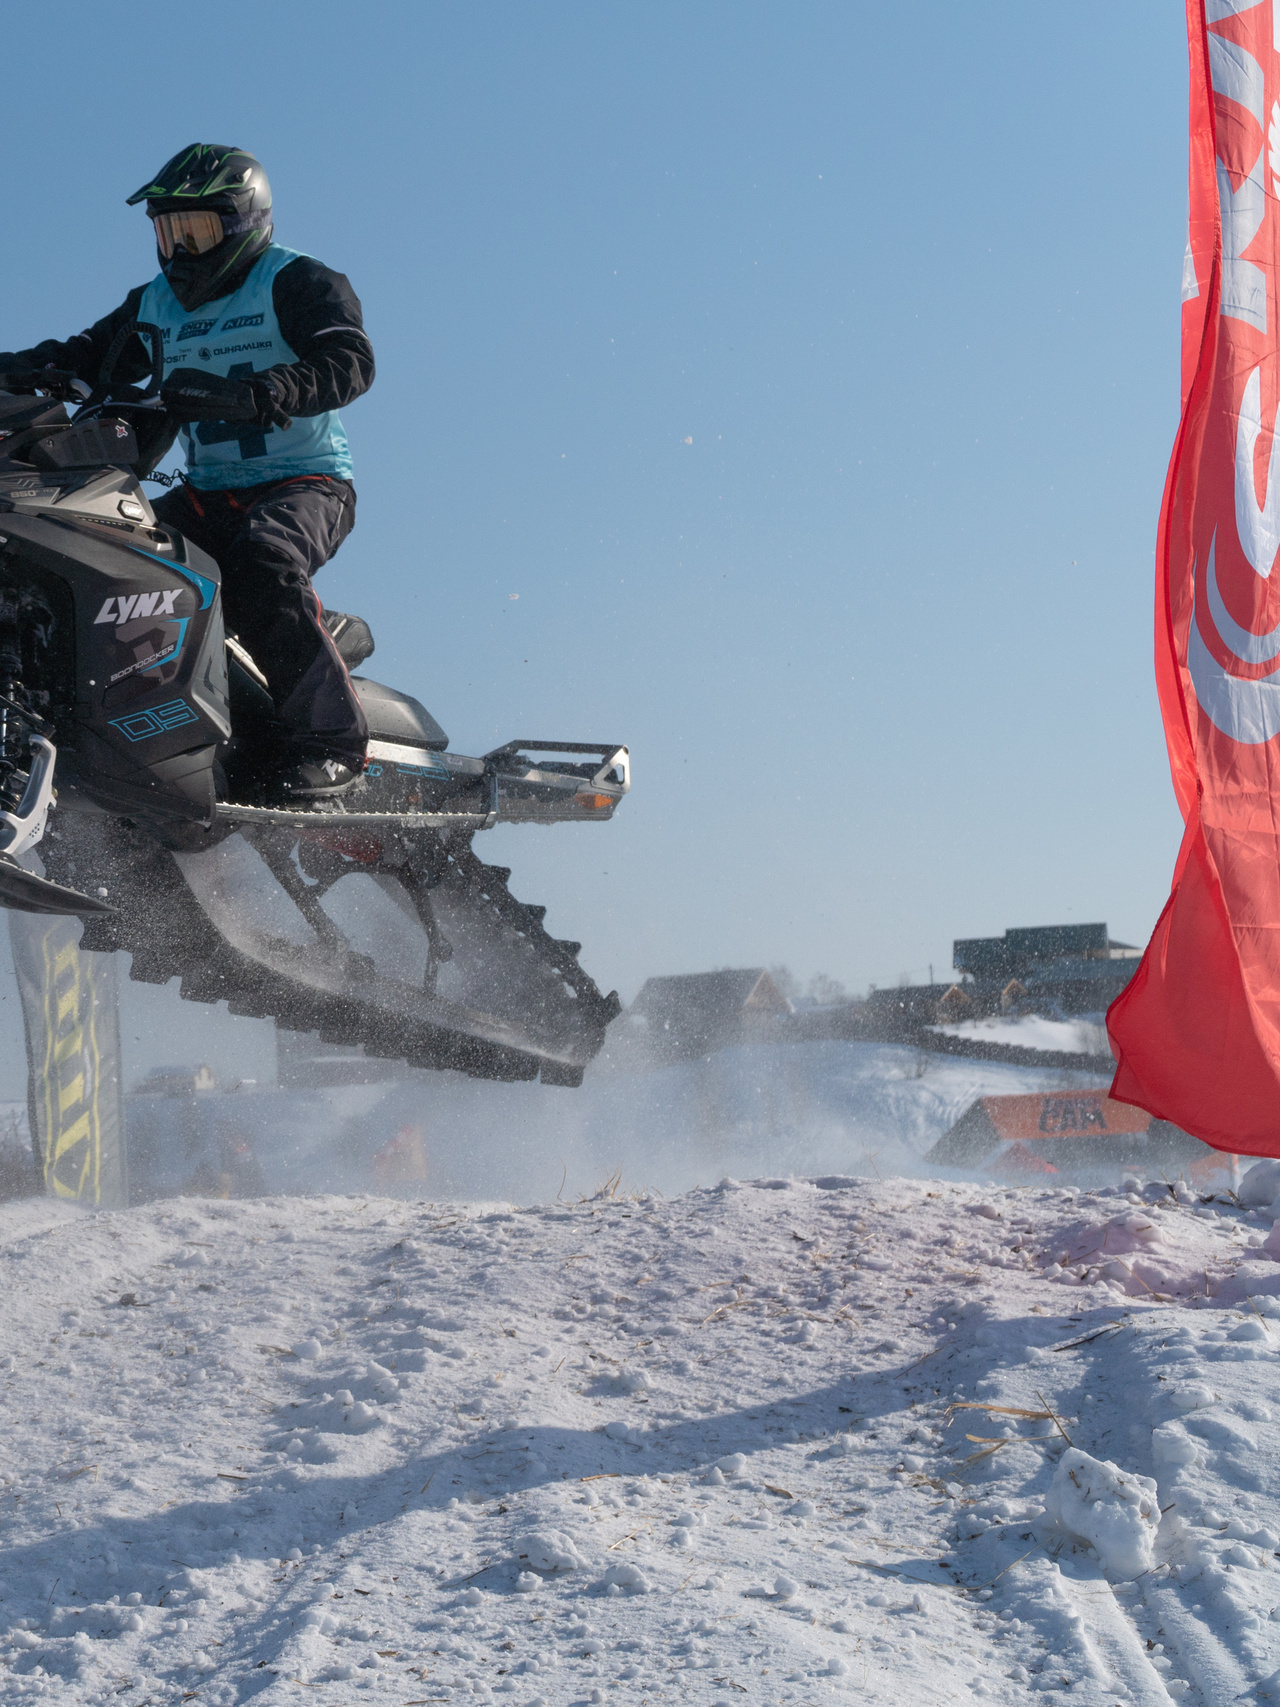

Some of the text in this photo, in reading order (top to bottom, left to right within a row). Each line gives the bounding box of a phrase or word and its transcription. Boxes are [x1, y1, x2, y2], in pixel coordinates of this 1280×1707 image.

[10, 489, 37, 499] 850
[93, 588, 184, 625] LYNX
[110, 644, 175, 682] BOONDOCKER
